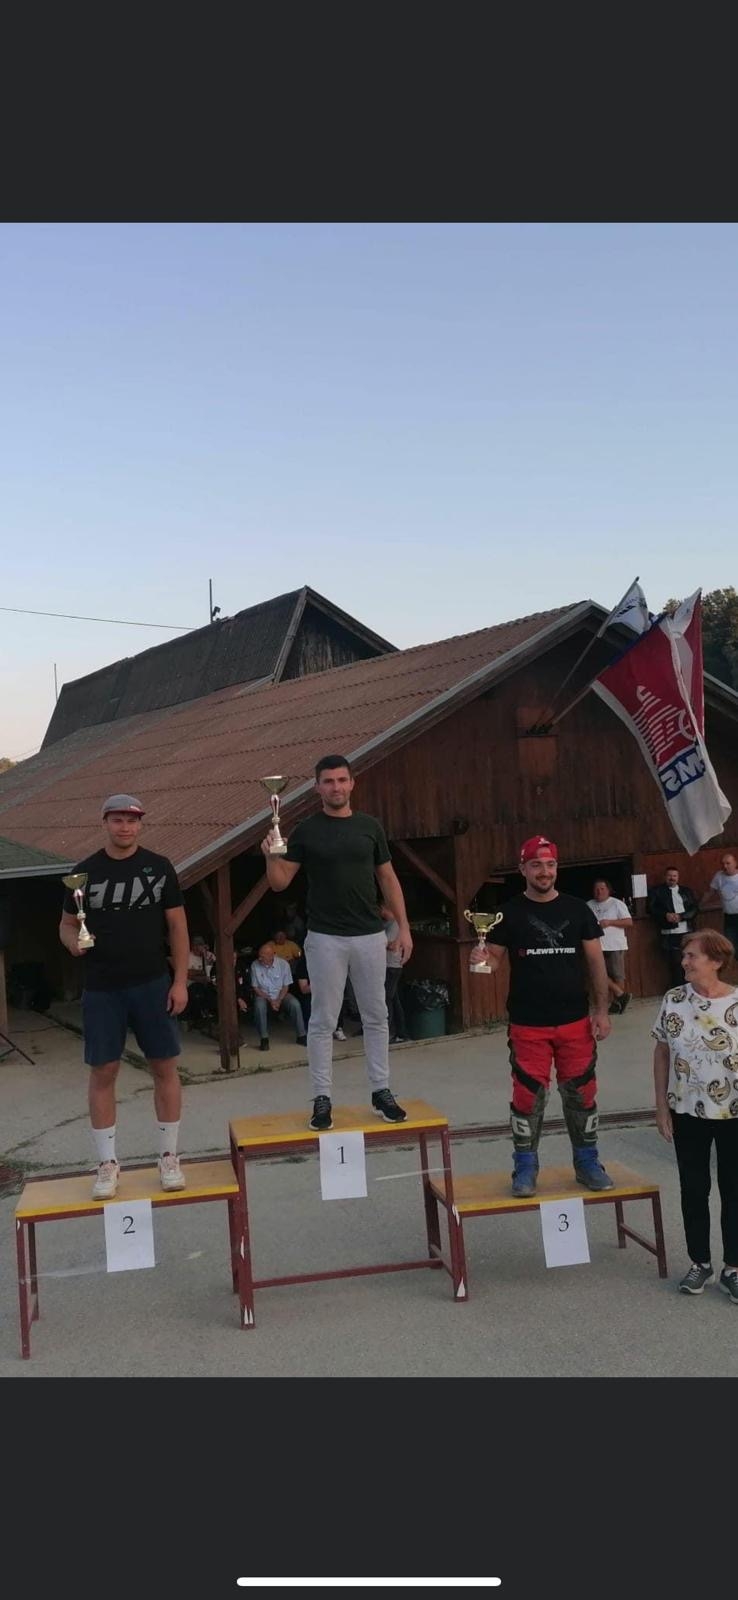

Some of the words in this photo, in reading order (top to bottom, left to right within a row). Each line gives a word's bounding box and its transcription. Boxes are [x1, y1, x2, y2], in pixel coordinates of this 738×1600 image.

[84, 875, 168, 911] FOX
[337, 1146, 348, 1164] 1
[122, 1215, 136, 1234] 2
[558, 1213, 570, 1232] 3
